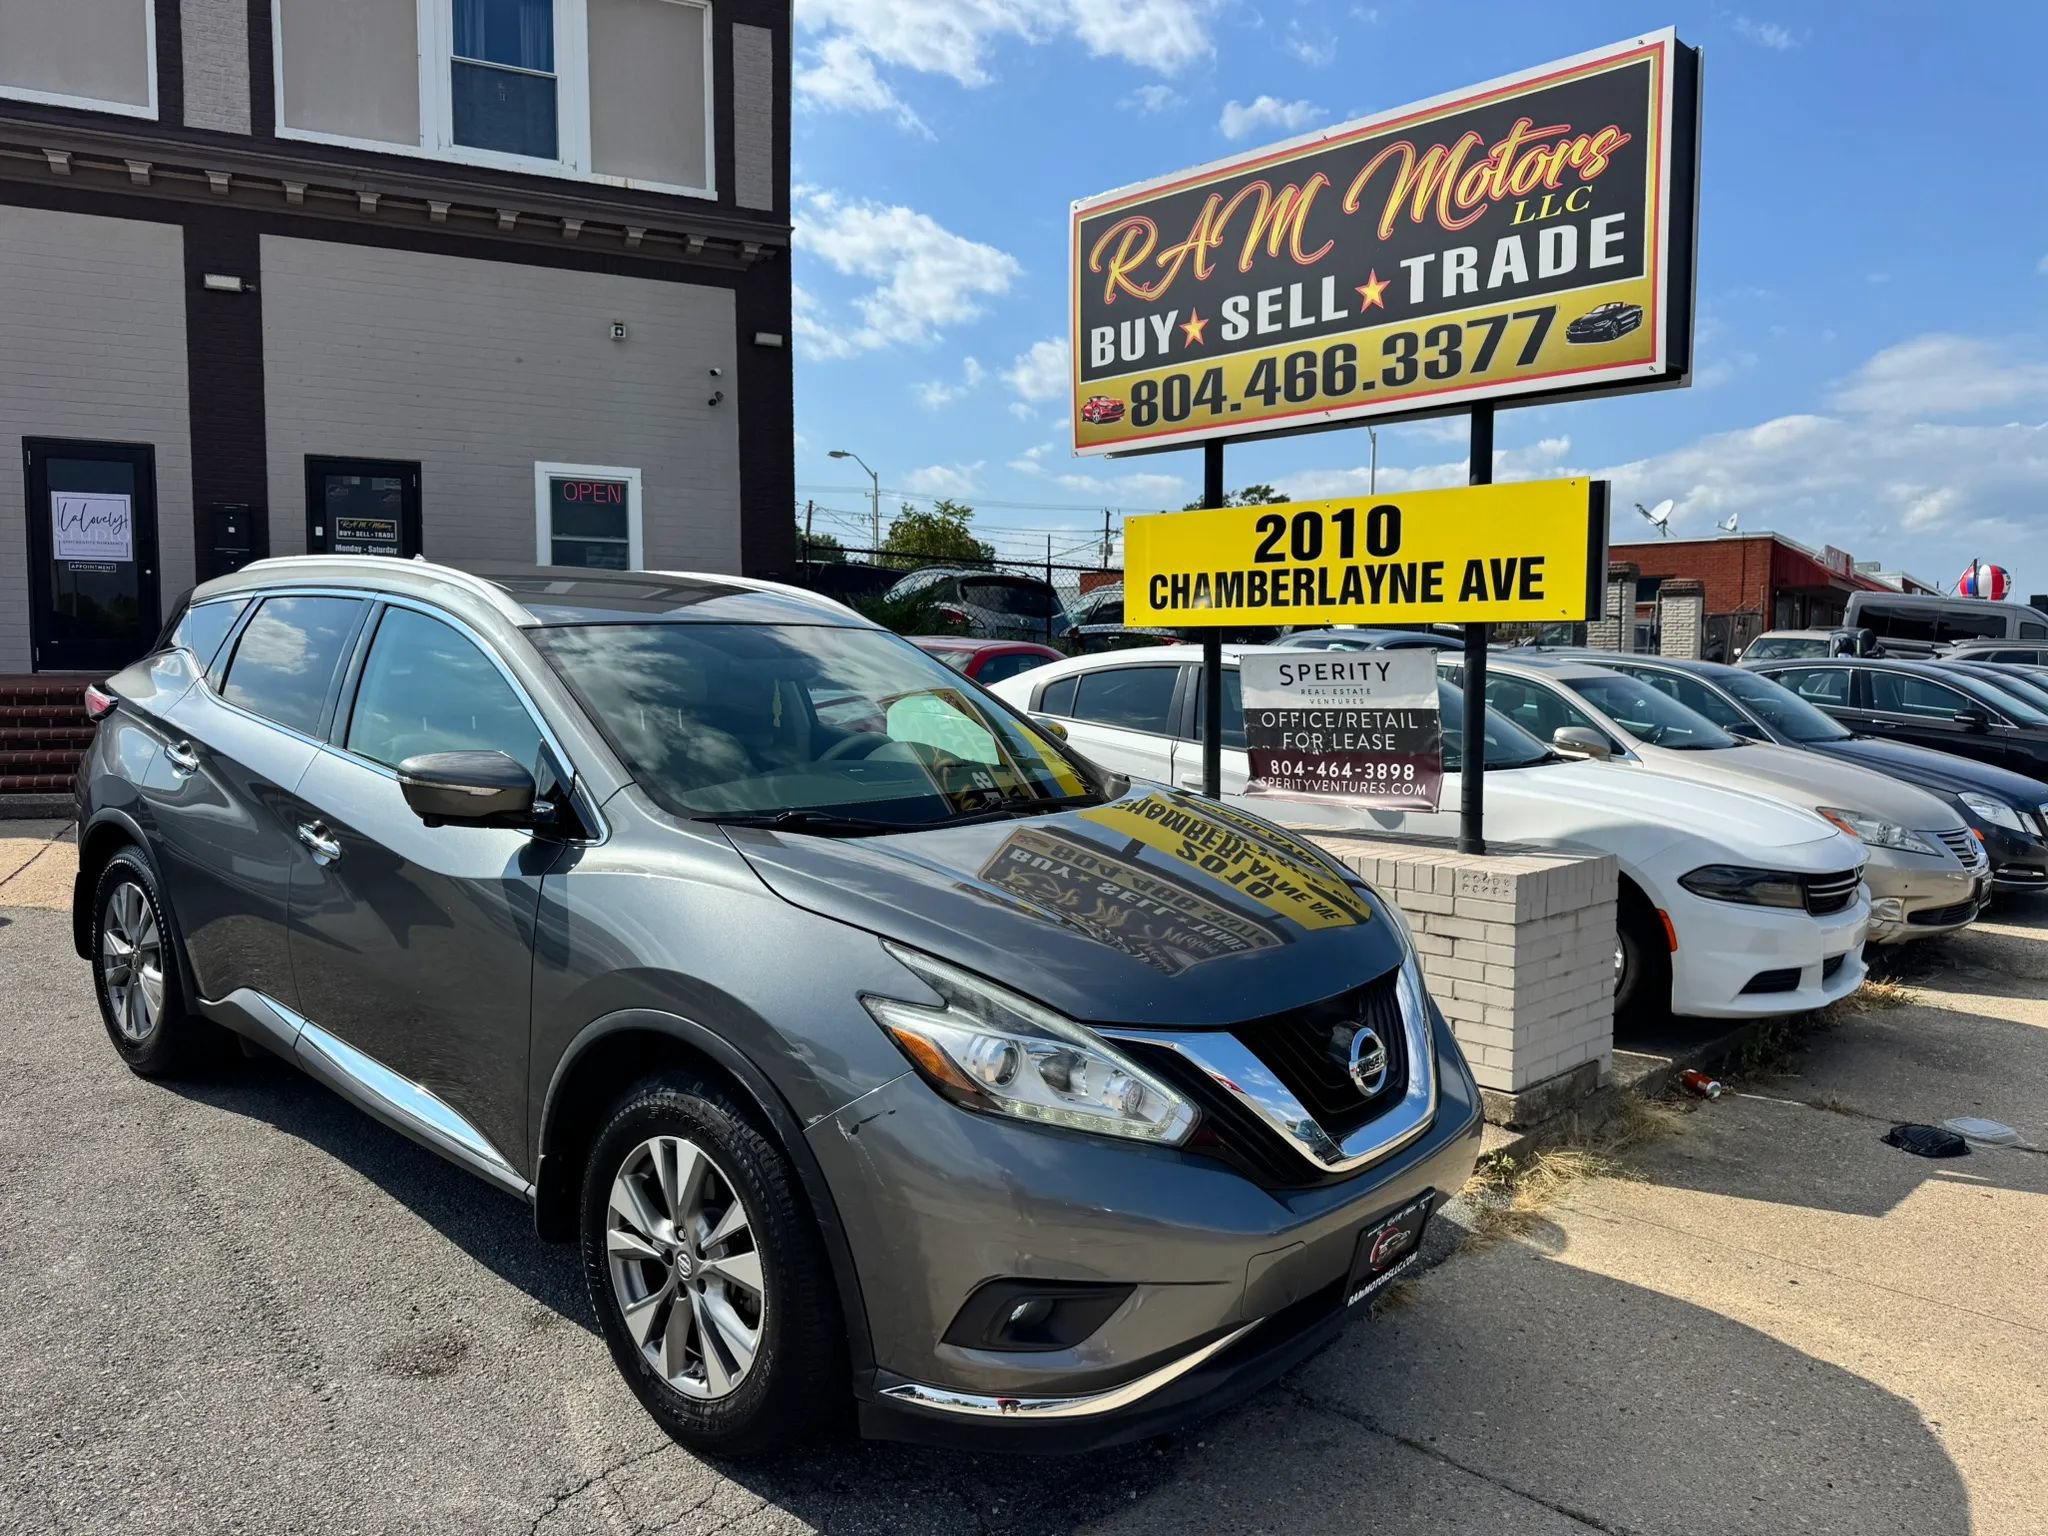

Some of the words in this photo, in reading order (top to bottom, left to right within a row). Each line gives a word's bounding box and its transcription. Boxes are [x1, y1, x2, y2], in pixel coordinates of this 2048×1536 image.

[1089, 172, 1335, 305] RAM
[1343, 117, 1632, 241] Motors
[1509, 185, 1593, 226] LLC
[1091, 309, 1179, 368] BUY
[1221, 275, 1349, 342] SELL
[1400, 212, 1626, 305] TRADE
[1130, 305, 1559, 428] 804.466.3377
[563, 482, 621, 504] OPEN
[1255, 505, 1402, 563] 2010
[335, 544, 362, 553] Monday
[368, 545, 398, 554] Saturday
[1149, 560, 1445, 610] CHAMBERLAYNE
[1459, 556, 1545, 603] AVE
[1279, 661, 1391, 686] SPERITY
[1333, 687, 1371, 695] ESTATE
[1261, 711, 1419, 729] OFFICE/RETAIL
[1283, 732, 1324, 749] FOR
[1333, 733, 1396, 750] LEASE
[1270, 759, 1415, 781] 804-464-3898
[1260, 776, 1426, 796] SPERITYVENTURES.COM
